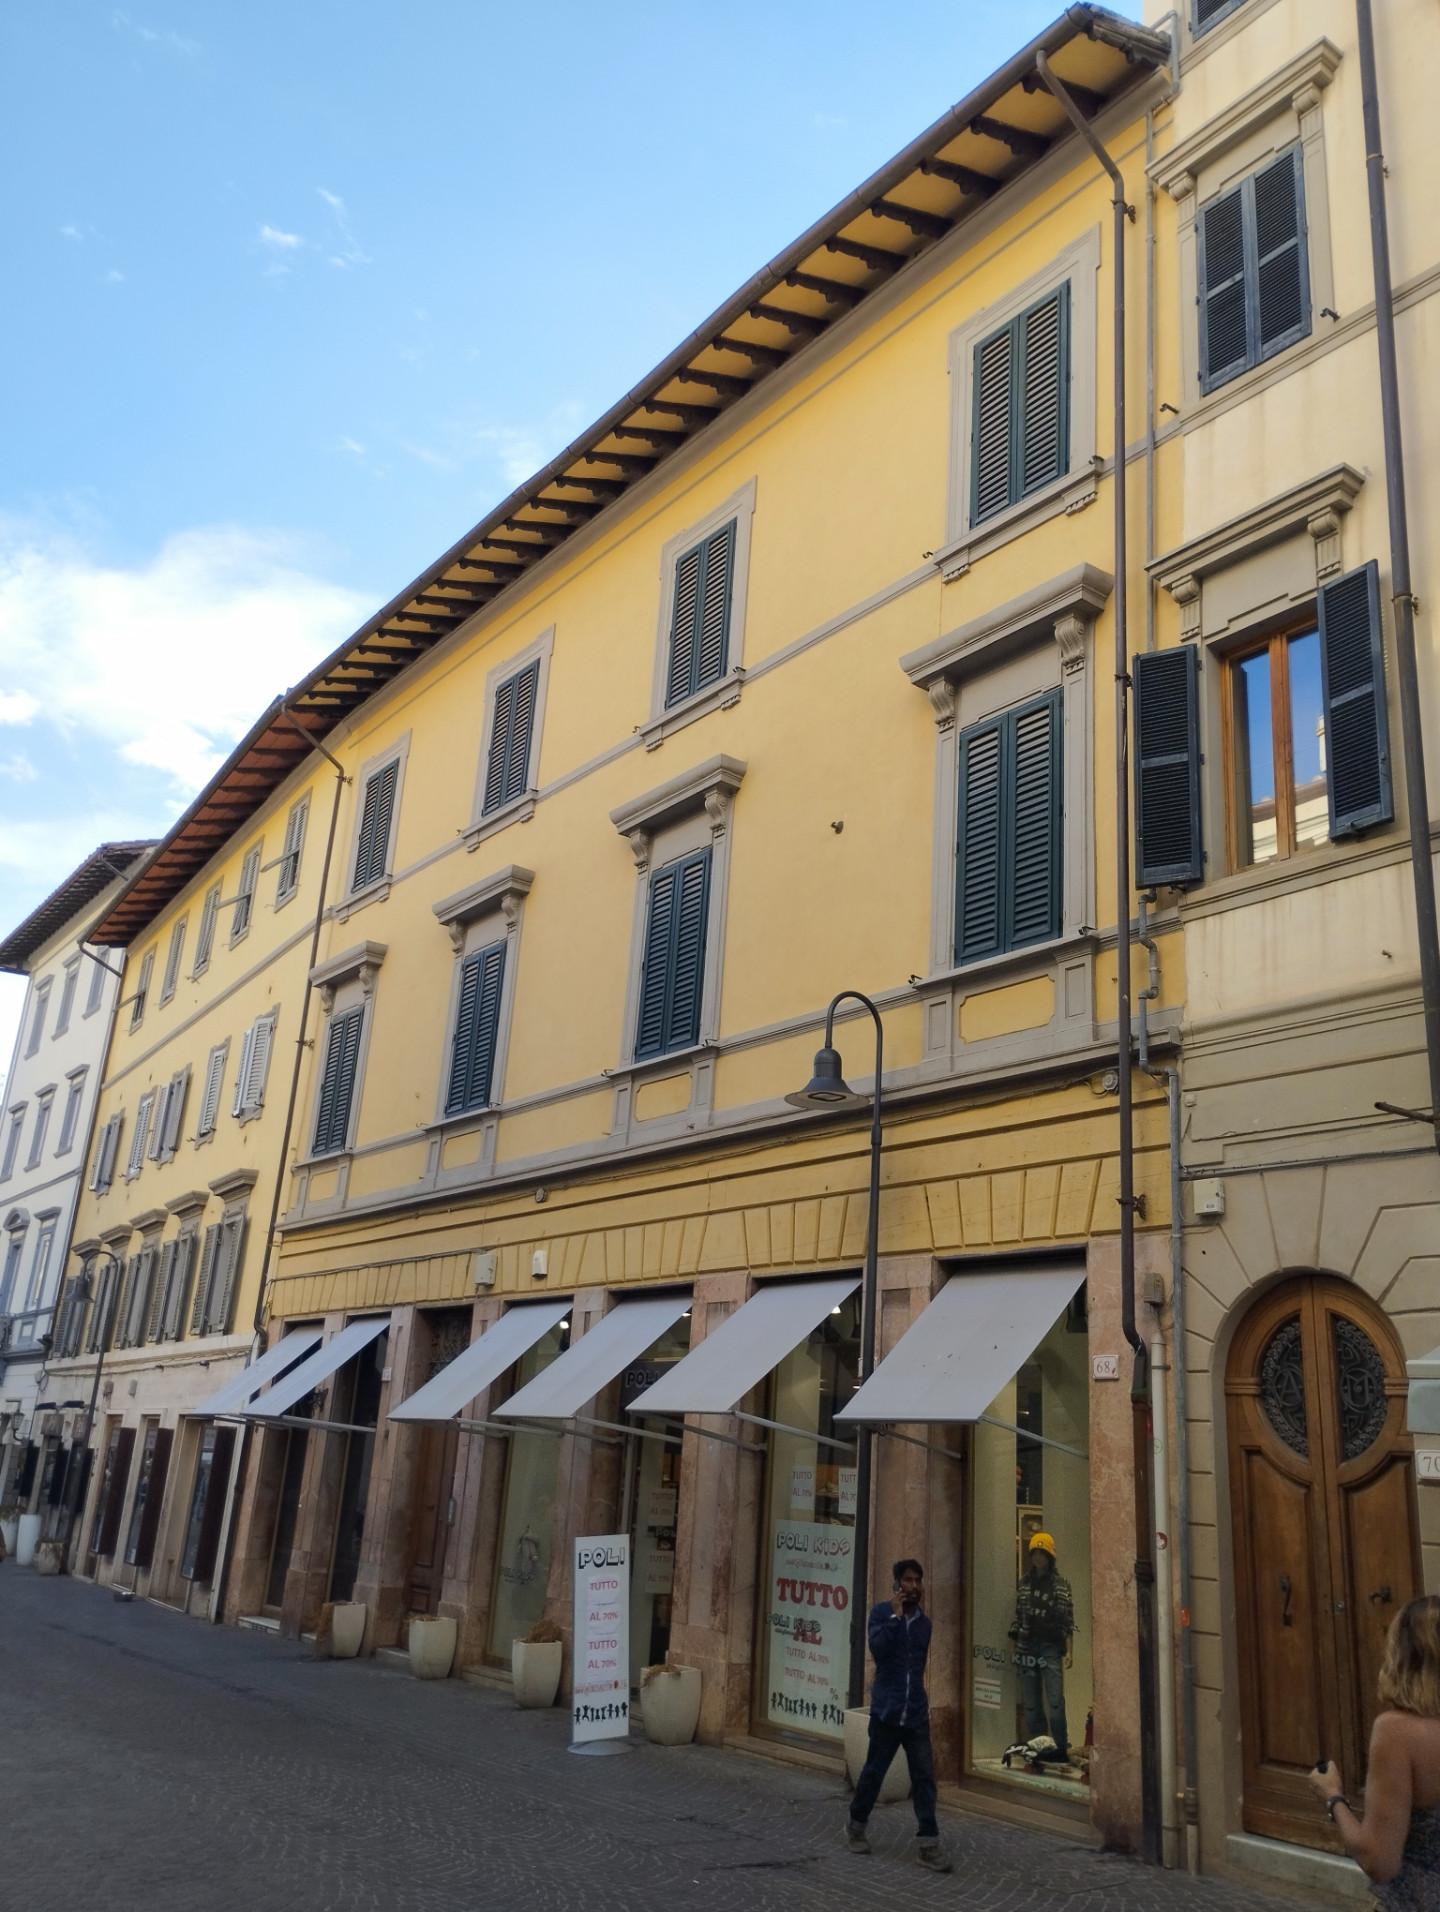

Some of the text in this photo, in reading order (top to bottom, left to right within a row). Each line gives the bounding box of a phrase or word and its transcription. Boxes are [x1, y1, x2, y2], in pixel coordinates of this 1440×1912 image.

[776, 1532, 851, 1556] POLI KIDS
[578, 1547, 626, 1569] POLI
[590, 1580, 618, 1591] TUTTO
[776, 1578, 849, 1611] TUTTO
[590, 1612, 601, 1621] AL
[588, 1639, 617, 1650] TUTTO
[588, 1659, 600, 1669] AL
